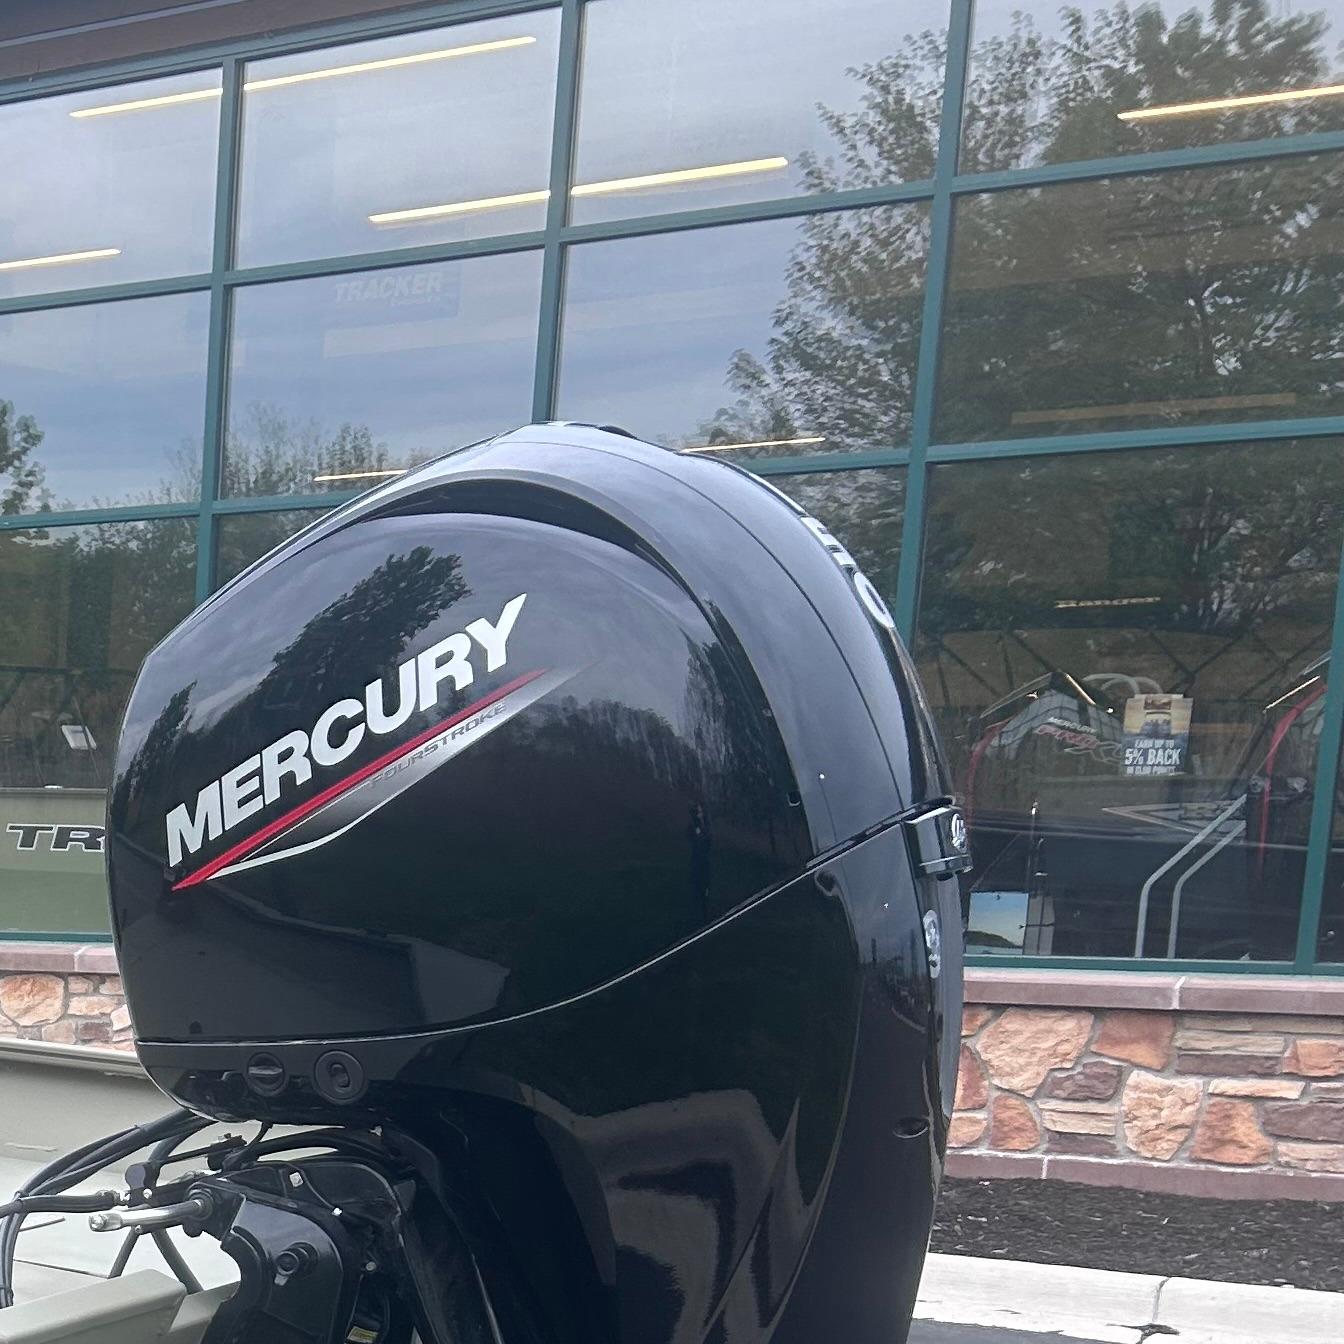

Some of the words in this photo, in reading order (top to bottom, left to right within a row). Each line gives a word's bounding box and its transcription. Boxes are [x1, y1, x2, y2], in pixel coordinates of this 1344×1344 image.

[165, 592, 528, 868] MERCURY
[369, 702, 508, 789] FOURSTROKE
[1124, 748, 1144, 765] 5%
[1146, 748, 1181, 765] BACK
[6, 822, 105, 853] TR
